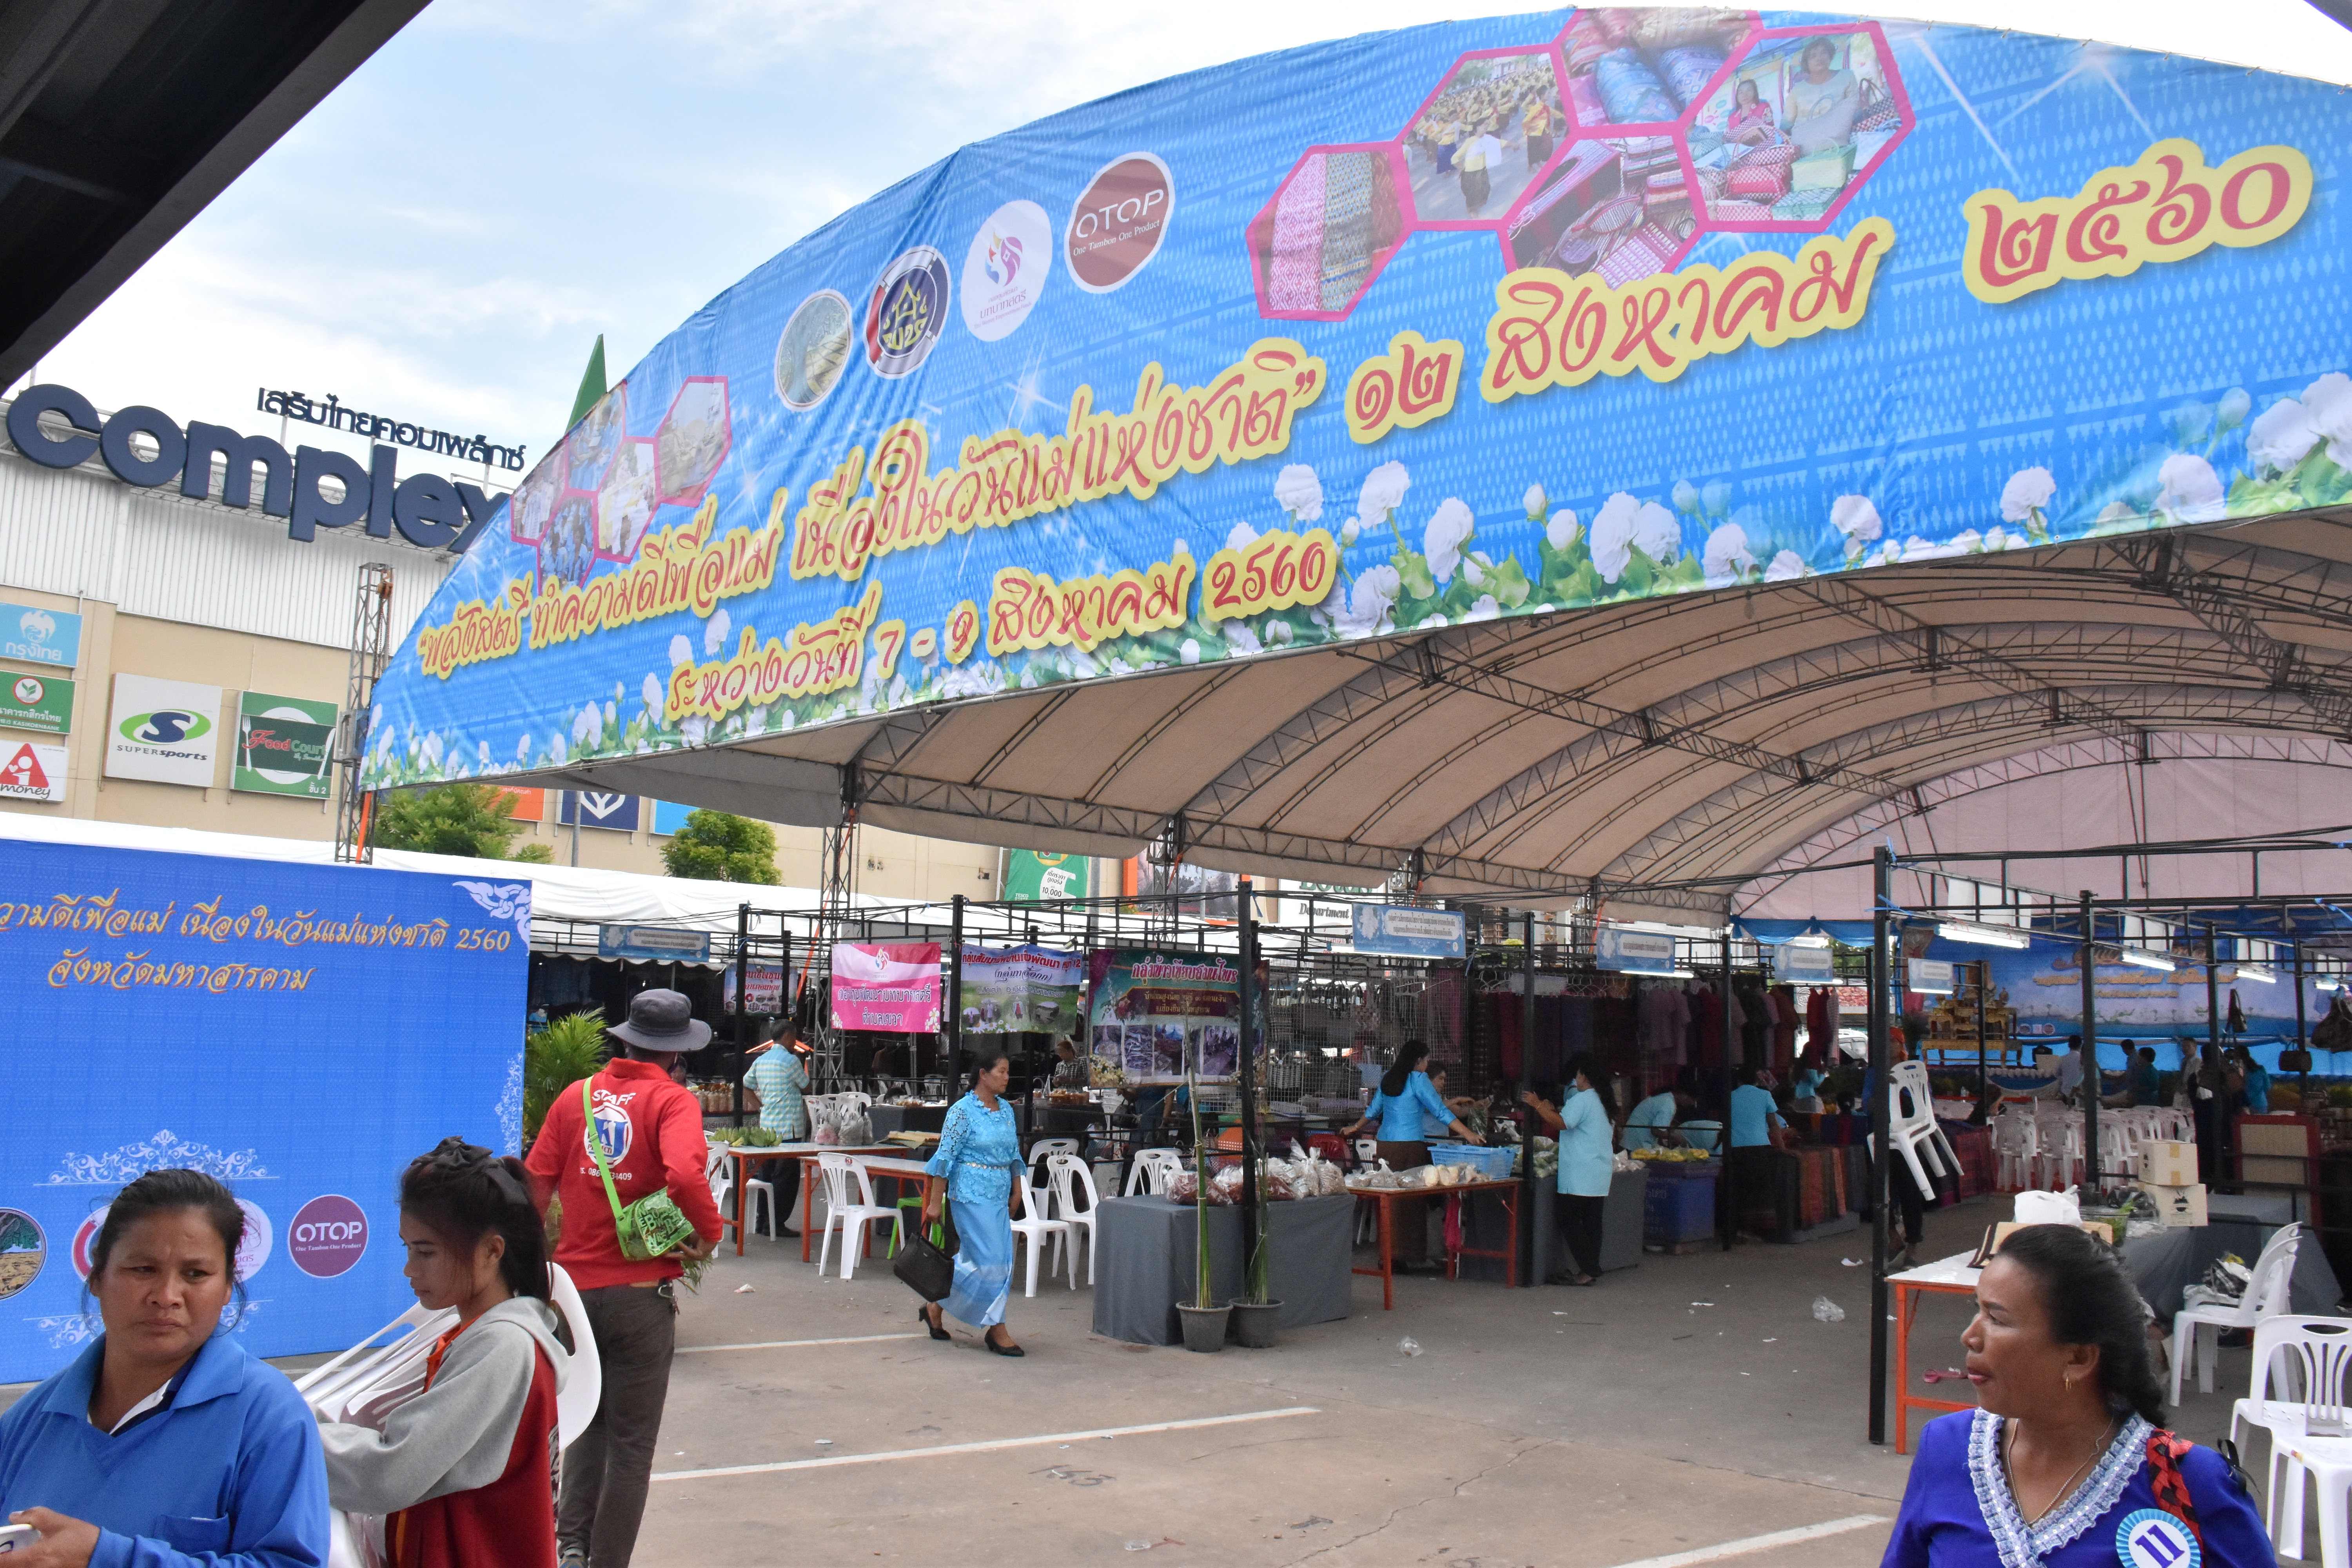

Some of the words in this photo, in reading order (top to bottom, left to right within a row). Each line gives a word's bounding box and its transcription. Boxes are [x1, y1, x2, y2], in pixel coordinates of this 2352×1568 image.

[1076, 189, 1164, 238] OTOP
[1073, 247, 1086, 256] One
[1089, 237, 1116, 251] Tambon
[1119, 231, 1132, 241] One
[1134, 220, 1160, 236] Product
[1486, 223, 1886, 396] สิงหาคม
[1971, 146, 2301, 296] ๒๕๖๐
[980, 289, 1026, 319] บทบาทสตรี
[257, 387, 527, 471] เสริมไทยคอมเพล็กซ์
[6, 383, 512, 554] complex
[668, 584, 880, 717] ระหว่างวันที่
[990, 557, 1192, 652] สิงหาคม
[1207, 534, 1334, 616] 2560
[5, 642, 62, 661] กรุงไทย
[13, 720, 60, 731] KASIKORNBANK
[117, 745, 208, 760] SUPERsports
[309, 781, 319, 793] ชั้น
[1042, 886, 1062, 897] 10,000
[181, 895, 451, 948] เนื่องในวันแม่แห่งชาติ
[455, 927, 510, 952] 2560
[47, 947, 317, 994] จังหวัดมหาสารคาม
[862, 1007, 903, 1026] ตำบลเขวา
[592, 1089, 636, 1105] STAFF
[296, 1221, 362, 1242] OTOP
[2135, 1524, 2185, 1568] 11
